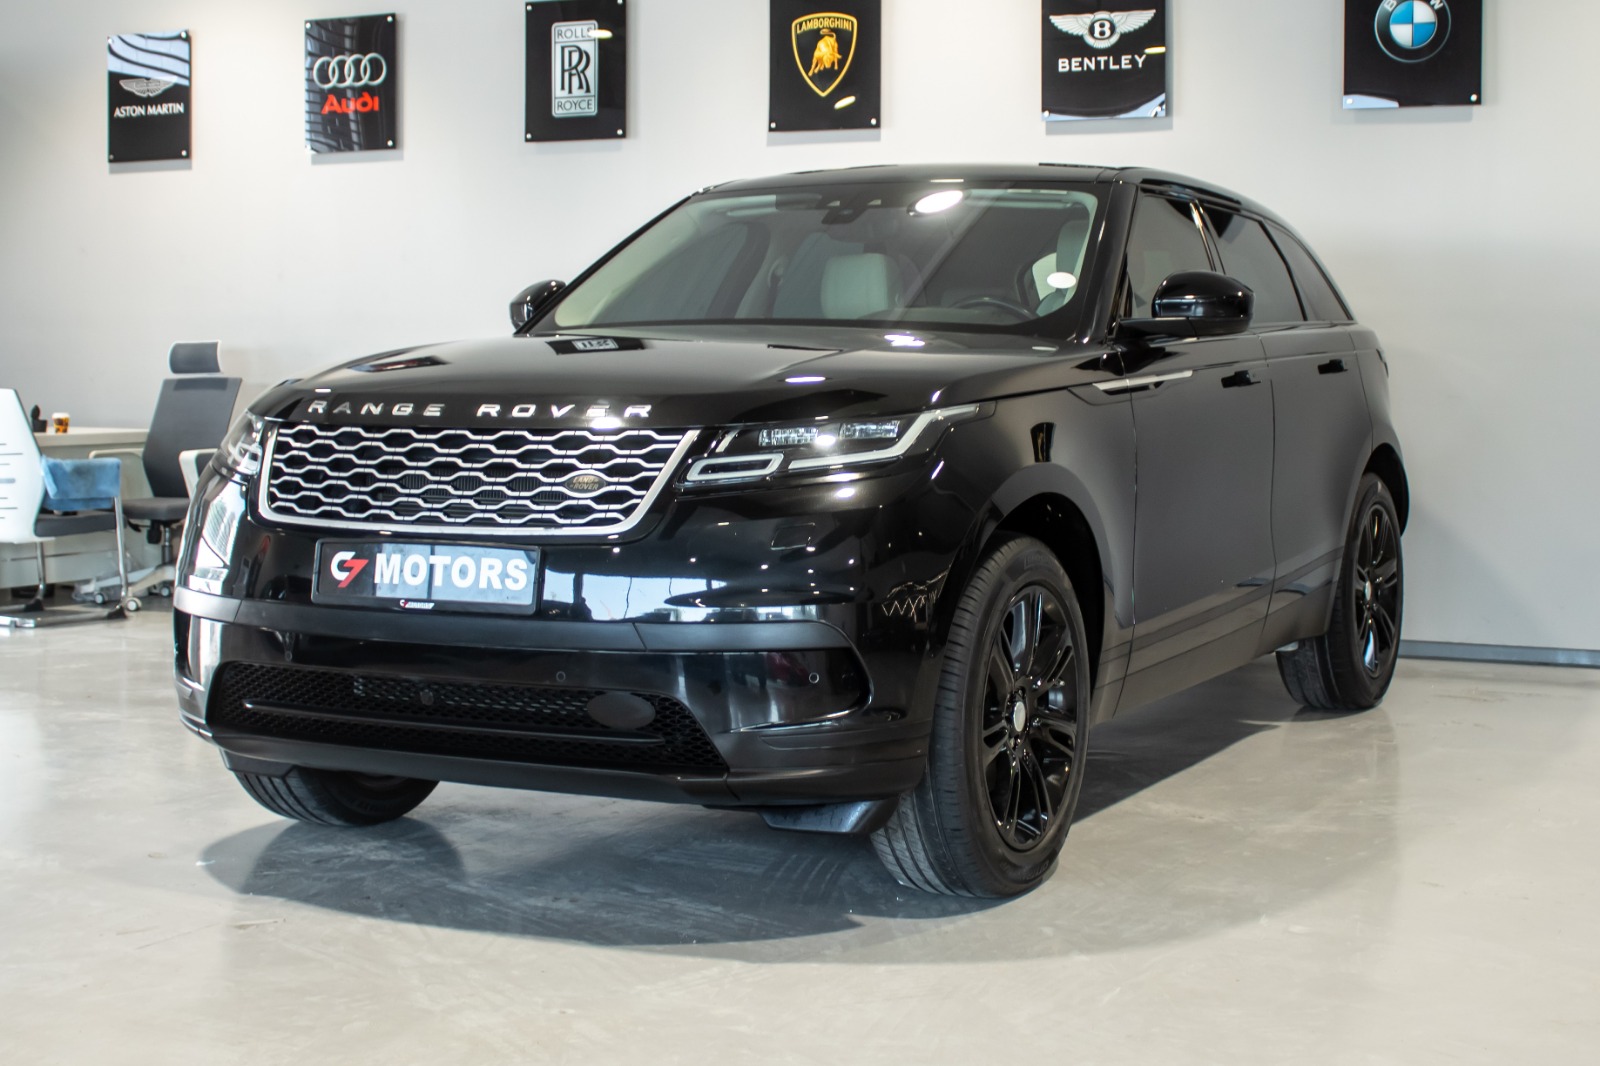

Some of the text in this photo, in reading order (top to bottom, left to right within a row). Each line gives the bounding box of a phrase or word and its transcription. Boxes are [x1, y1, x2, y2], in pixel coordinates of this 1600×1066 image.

[1383, 0, 1444, 12] BW
[796, 17, 852, 34] LAMBORGHINI
[1058, 54, 1146, 72] BENTLEY
[113, 102, 184, 118] ASTON MARTIN
[321, 91, 379, 115] Audi
[556, 99, 593, 111] ROYCE
[307, 400, 652, 418] RANGE ROVER
[374, 553, 528, 591] MOTORS
